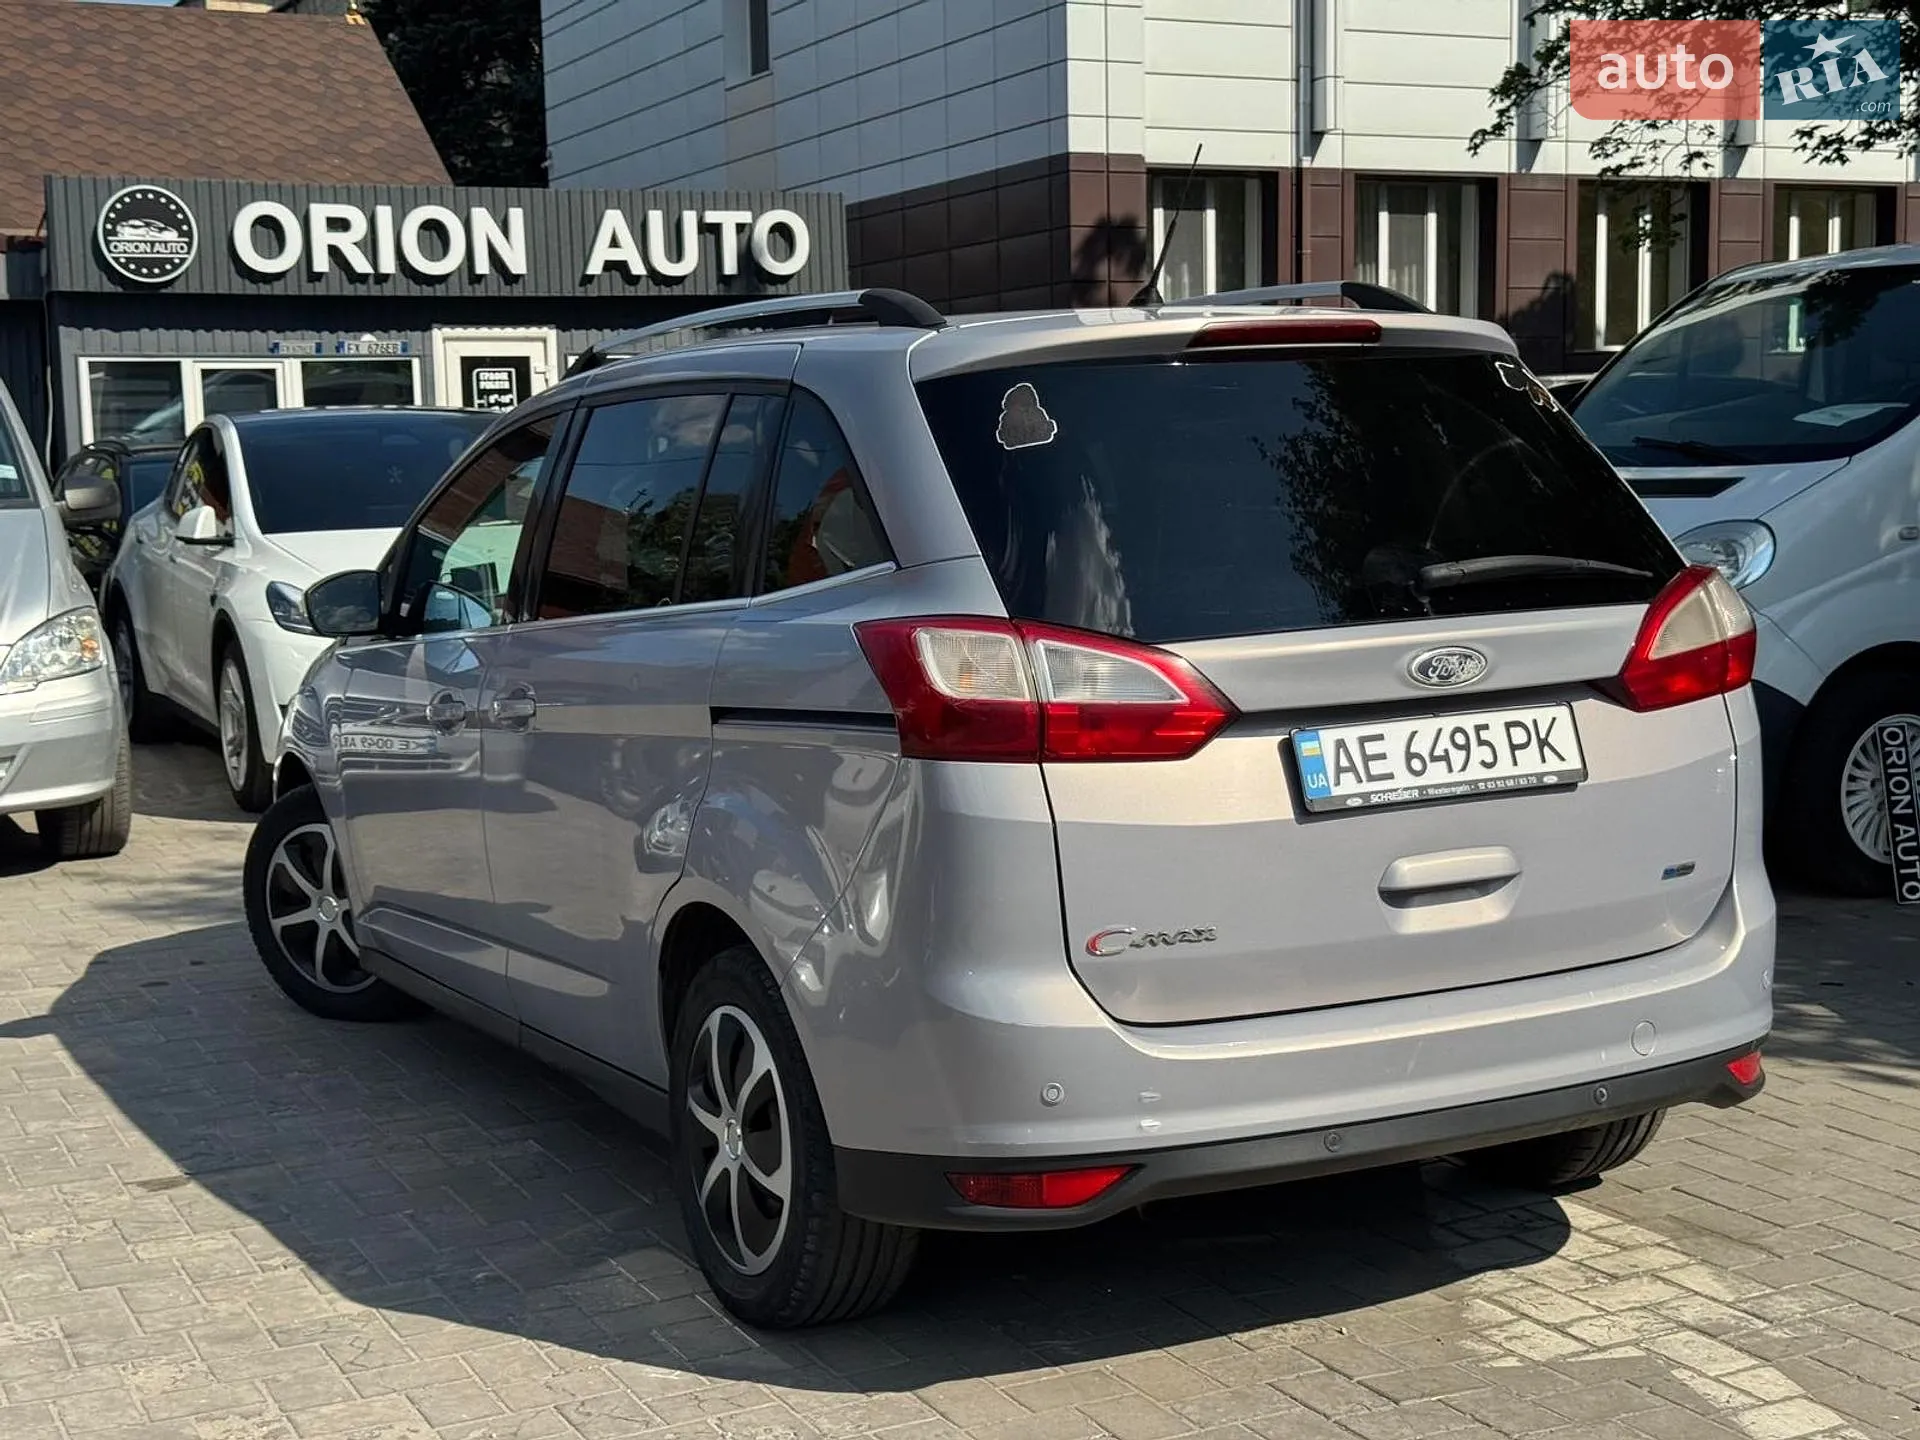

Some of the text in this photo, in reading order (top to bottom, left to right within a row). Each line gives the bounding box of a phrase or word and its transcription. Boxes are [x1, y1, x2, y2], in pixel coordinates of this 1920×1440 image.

[110, 241, 188, 253] ORION AUTO
[233, 201, 810, 276] ORION AUTO
[1307, 774, 1328, 790] UA
[1333, 717, 1567, 787] AE 6495 PK
[1882, 727, 1920, 900] ORION AUTO
